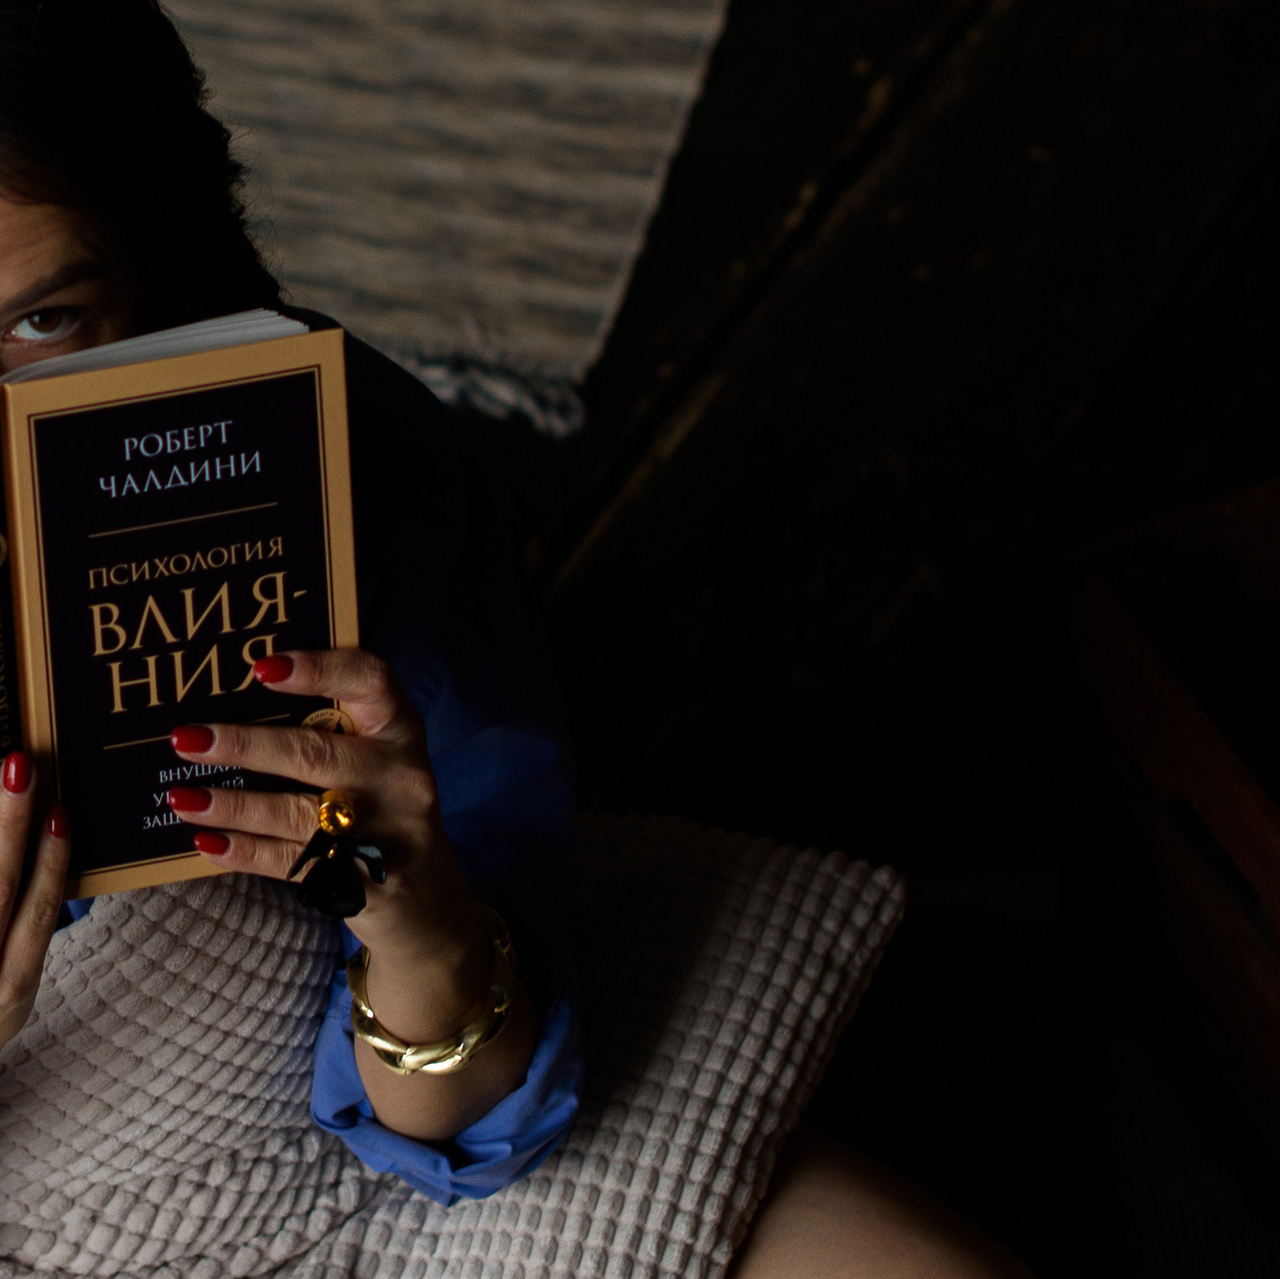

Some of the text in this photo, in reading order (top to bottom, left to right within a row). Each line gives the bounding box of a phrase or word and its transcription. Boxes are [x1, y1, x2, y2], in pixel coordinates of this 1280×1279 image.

[123, 420, 233, 461] РОБЕРТ
[99, 450, 262, 498] ЧАЛДИНИ
[88, 536, 284, 590] ПСИХОЛОГИЯ
[88, 571, 308, 657] ВЛИЯ-
